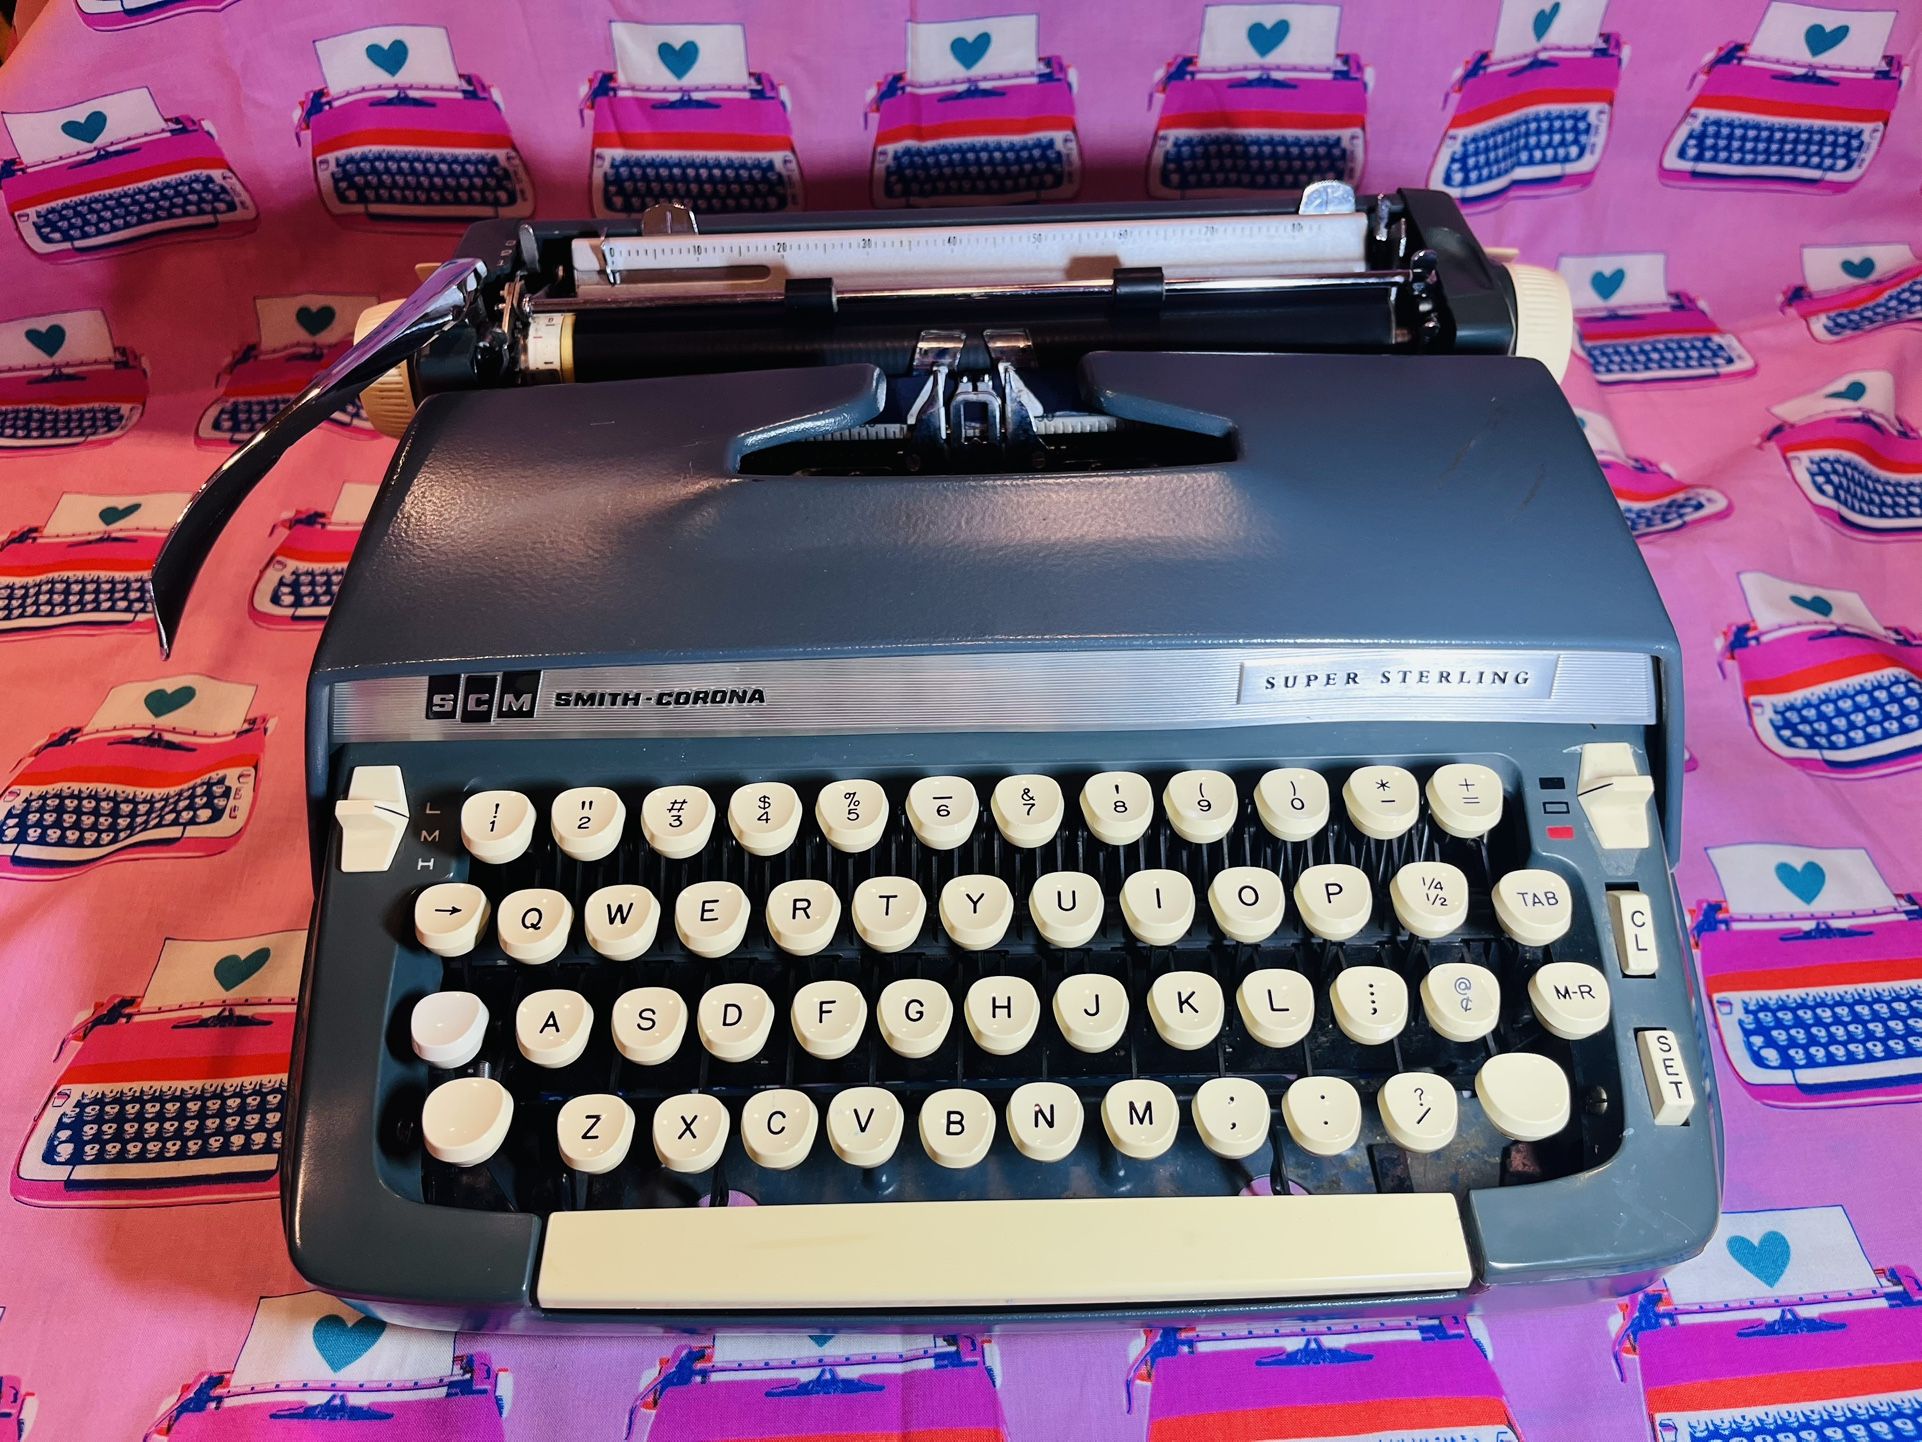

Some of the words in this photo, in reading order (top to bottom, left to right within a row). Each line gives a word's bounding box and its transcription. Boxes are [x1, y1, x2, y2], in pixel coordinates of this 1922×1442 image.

[609, 247, 615, 258] 0
[692, 244, 703, 256] 10
[776, 242, 787, 252] 20
[862, 238, 872, 249] 30
[947, 236, 956, 247] 40
[1032, 233, 1042, 244] 50
[1265, 671, 1360, 690] SUPER
[1380, 669, 1530, 686] STERLING
[432, 693, 532, 712] SCM
[555, 688, 766, 707] SMITH-CORONA
[1021, 787, 1035, 802] &
[1290, 780, 1296, 797] )
[1459, 778, 1476, 792] +
[425, 802, 440, 813] L
[667, 799, 689, 813] #
[757, 795, 771, 810] $
[844, 792, 860, 808] %
[1022, 802, 1036, 816] 7
[1113, 799, 1127, 814] 8
[1197, 799, 1212, 813] 9
[1462, 796, 1481, 805] =
[493, 803, 500, 819] !
[668, 815, 684, 828] 3
[757, 811, 771, 824] 4
[846, 808, 860, 821] 5
[936, 804, 951, 818] 6
[488, 819, 496, 833] 1
[577, 816, 592, 829] 2
[421, 830, 440, 842] M
[417, 858, 434, 870] H
[965, 892, 985, 914] Y
[1056, 890, 1077, 912] U
[1155, 887, 1162, 910] I
[1238, 885, 1259, 907] O
[1324, 883, 1343, 904] P
[1516, 891, 1559, 907] TAB
[606, 902, 633, 925] W
[699, 899, 720, 922] E
[792, 898, 811, 920] R
[878, 894, 898, 916] T
[521, 908, 542, 930] Q
[1455, 977, 1472, 994] @
[1554, 984, 1596, 1000] M-R
[904, 999, 924, 1022] G
[992, 996, 1012, 1018] H
[1083, 994, 1100, 1017] J
[1177, 991, 1199, 1013] K
[1267, 989, 1290, 1012] L
[637, 1008, 657, 1031] S
[722, 1003, 742, 1026] D
[818, 1000, 837, 1023] F
[539, 1011, 560, 1034] A
[1656, 1035, 1683, 1099] SET
[1413, 1087, 1425, 1107] ?
[766, 1111, 786, 1135] C
[853, 1108, 874, 1133] V
[945, 1110, 965, 1136] B
[1033, 1103, 1055, 1129] N
[1128, 1101, 1154, 1125] M
[581, 1115, 601, 1140] Z
[677, 1115, 698, 1140] X
